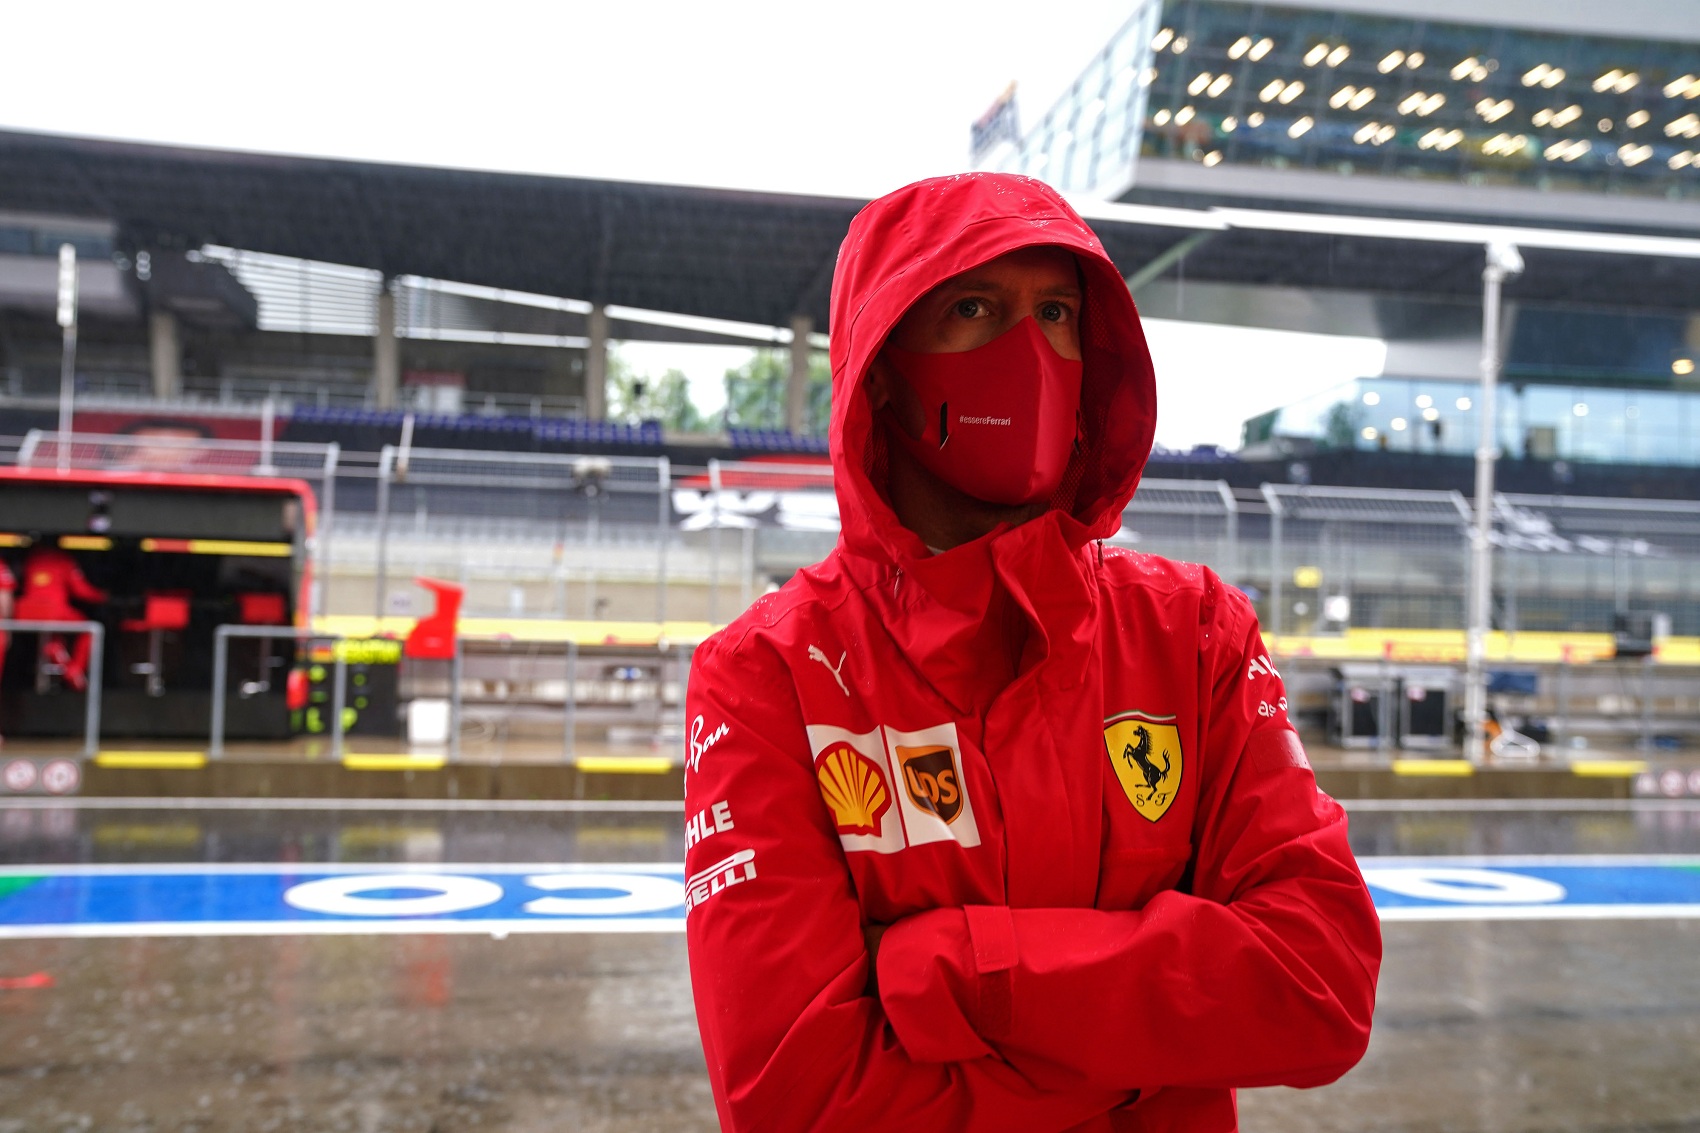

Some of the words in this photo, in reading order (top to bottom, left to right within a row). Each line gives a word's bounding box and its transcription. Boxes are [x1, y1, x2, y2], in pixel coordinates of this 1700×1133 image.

[959, 415, 1011, 425] #essereFerrari
[905, 765, 959, 812] ups
[685, 800, 735, 853] HLE
